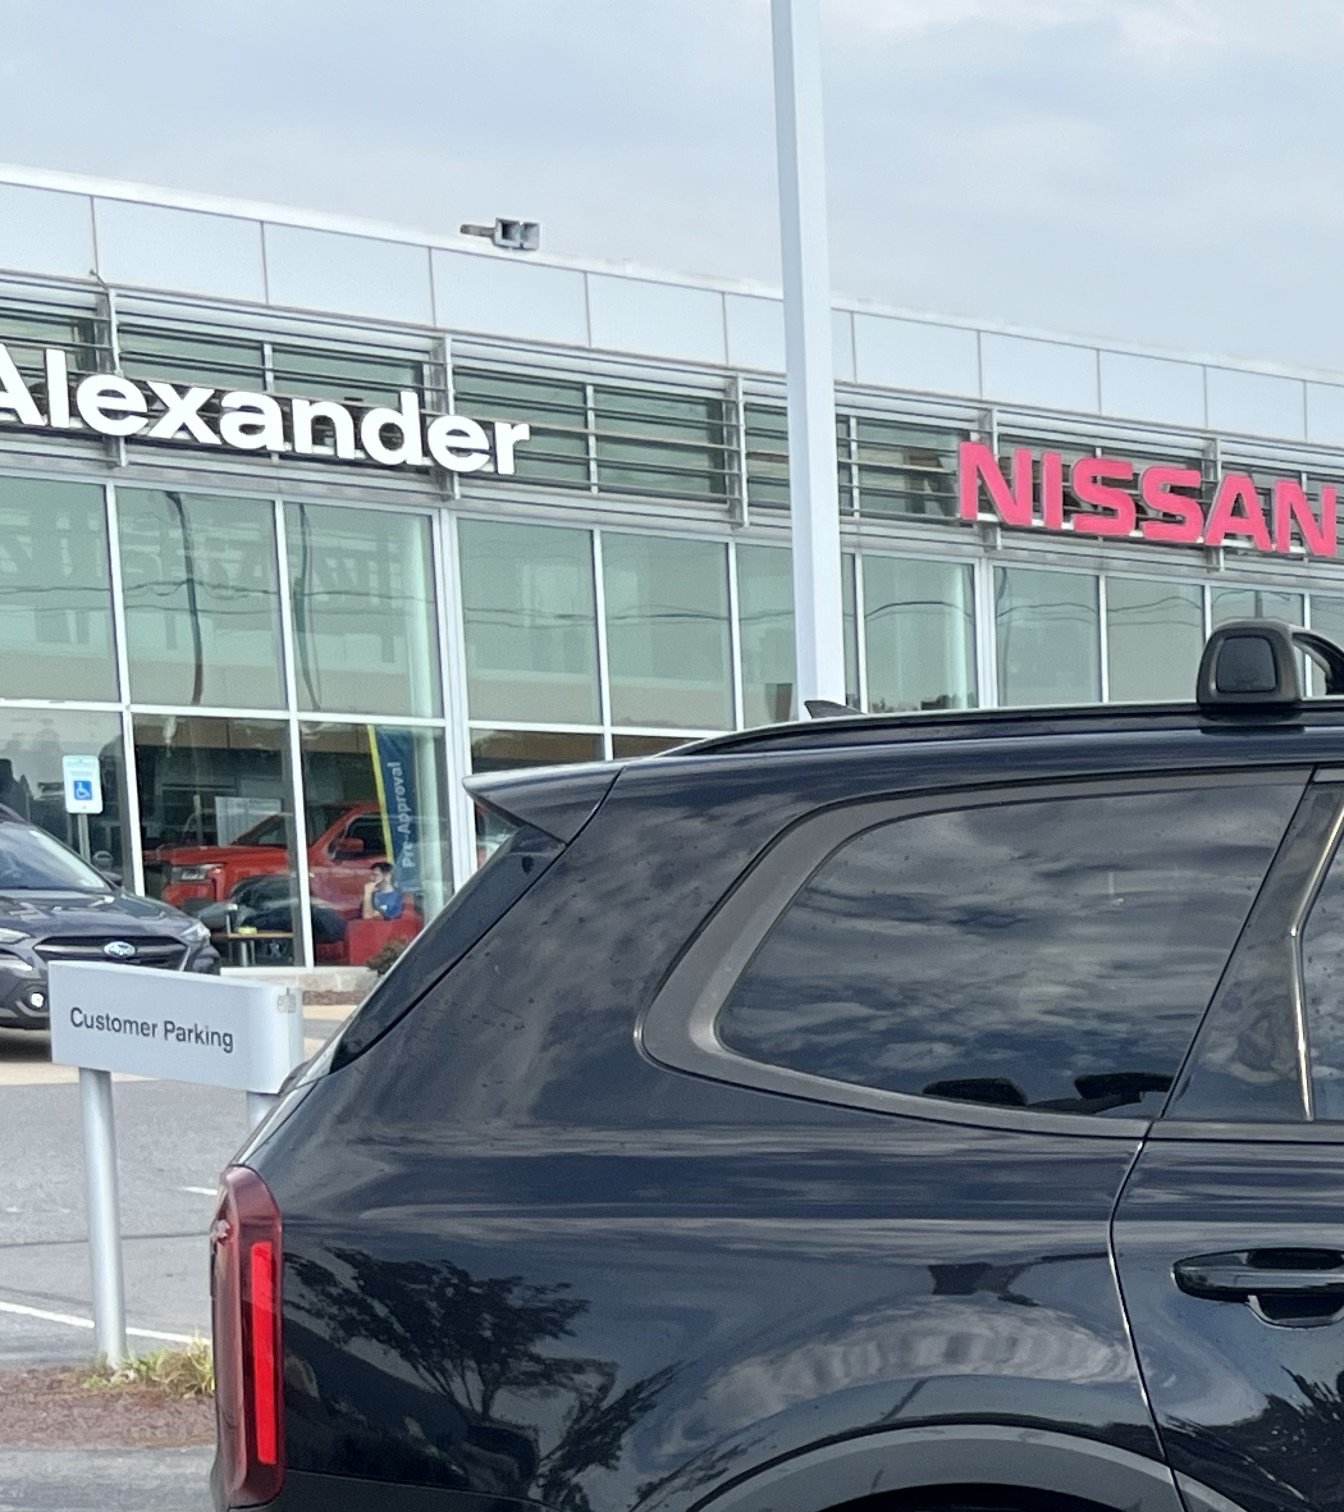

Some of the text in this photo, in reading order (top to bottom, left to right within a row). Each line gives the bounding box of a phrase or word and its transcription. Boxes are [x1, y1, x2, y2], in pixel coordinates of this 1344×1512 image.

[958, 440, 1337, 557] NISSAN
[387, 761, 416, 869] Pre-Approval
[70, 1006, 233, 1053] Customer Parking
